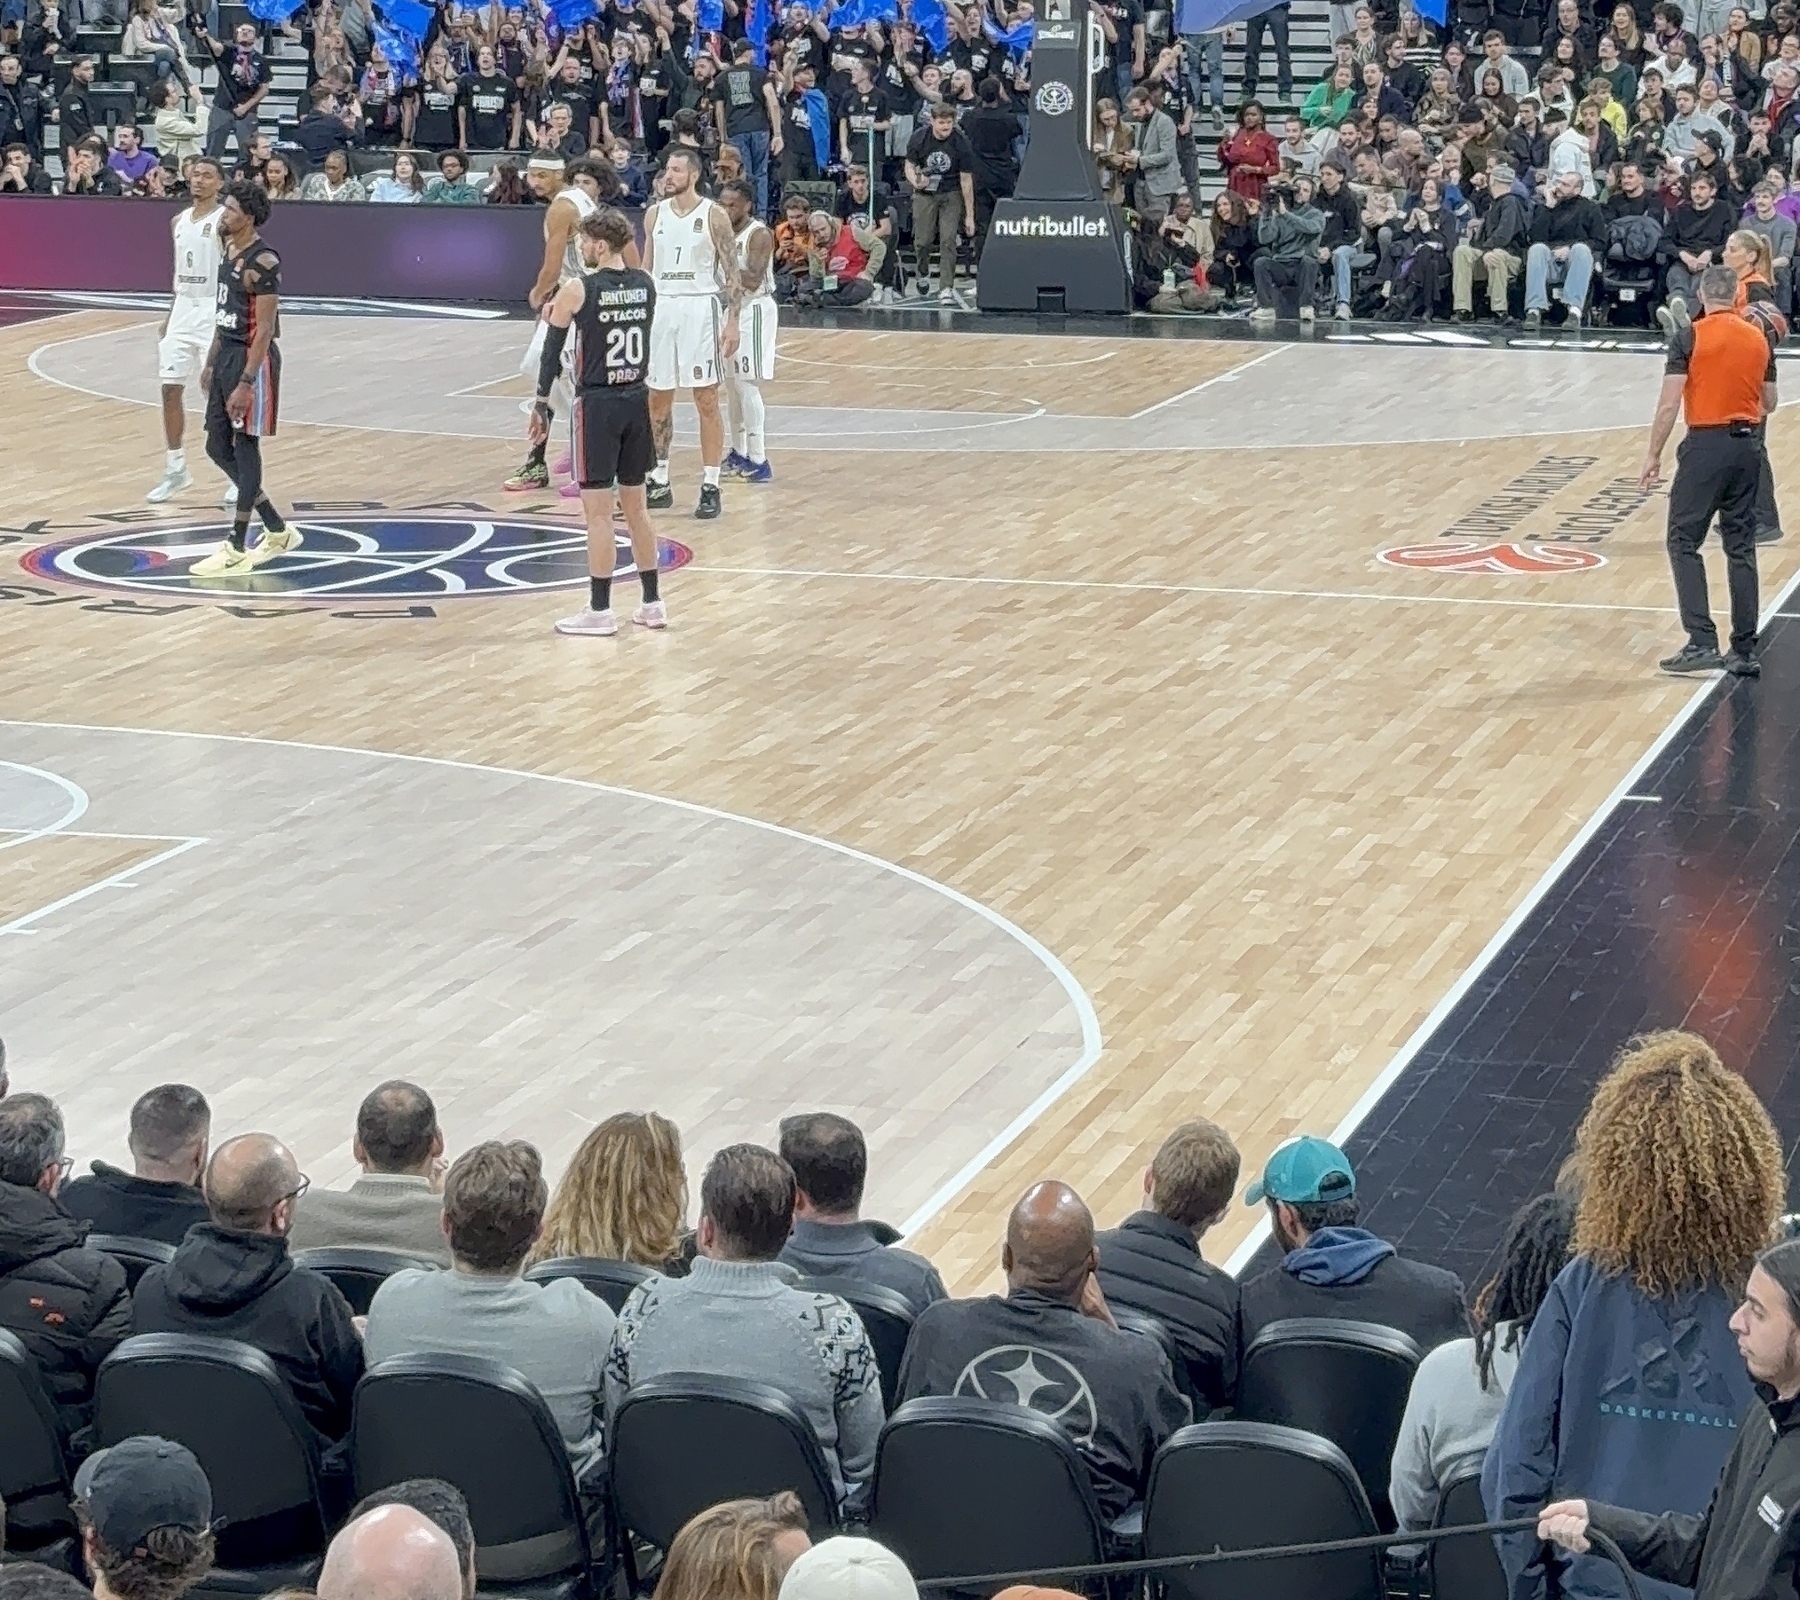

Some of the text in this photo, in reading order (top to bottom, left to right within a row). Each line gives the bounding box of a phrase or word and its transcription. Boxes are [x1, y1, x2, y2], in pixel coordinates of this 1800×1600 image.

[674, 247, 682, 265] 7
[598, 288, 648, 306] JANTUNEN
[606, 326, 643, 367] 20
[705, 359, 714, 378] 7
[1438, 455, 1600, 537] TURKISH AIRLINES
[1600, 1402, 1738, 1429] BASKETBALL
